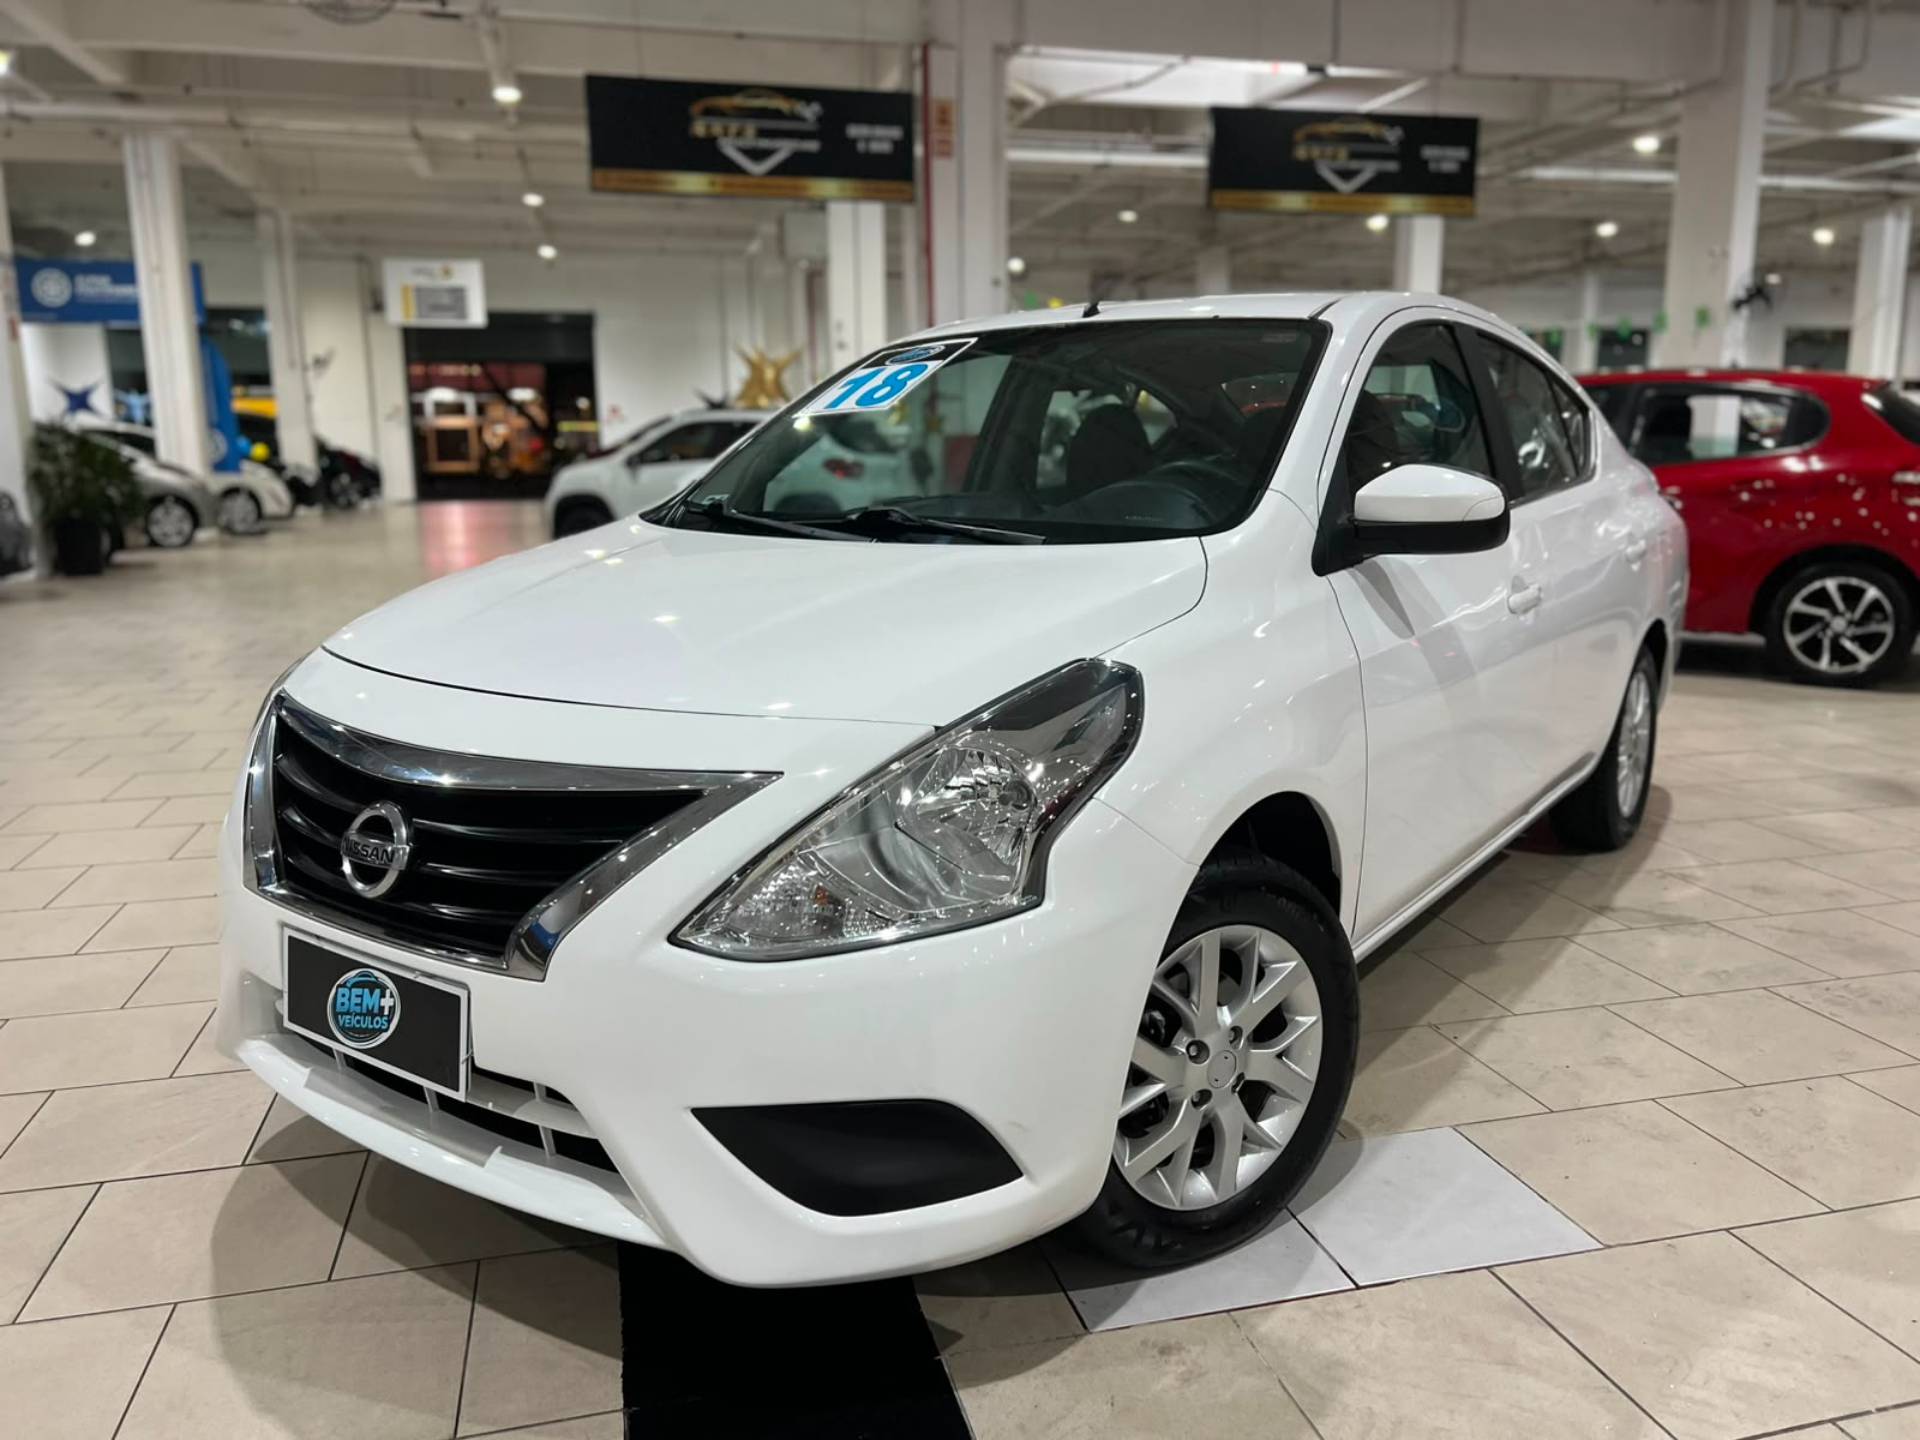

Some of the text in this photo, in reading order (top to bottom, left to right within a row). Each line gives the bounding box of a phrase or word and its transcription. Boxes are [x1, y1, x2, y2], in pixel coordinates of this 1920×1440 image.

[824, 362, 929, 410] 18
[342, 836, 396, 865] NISSAN
[337, 1012, 389, 1030] VEÍCULOS
